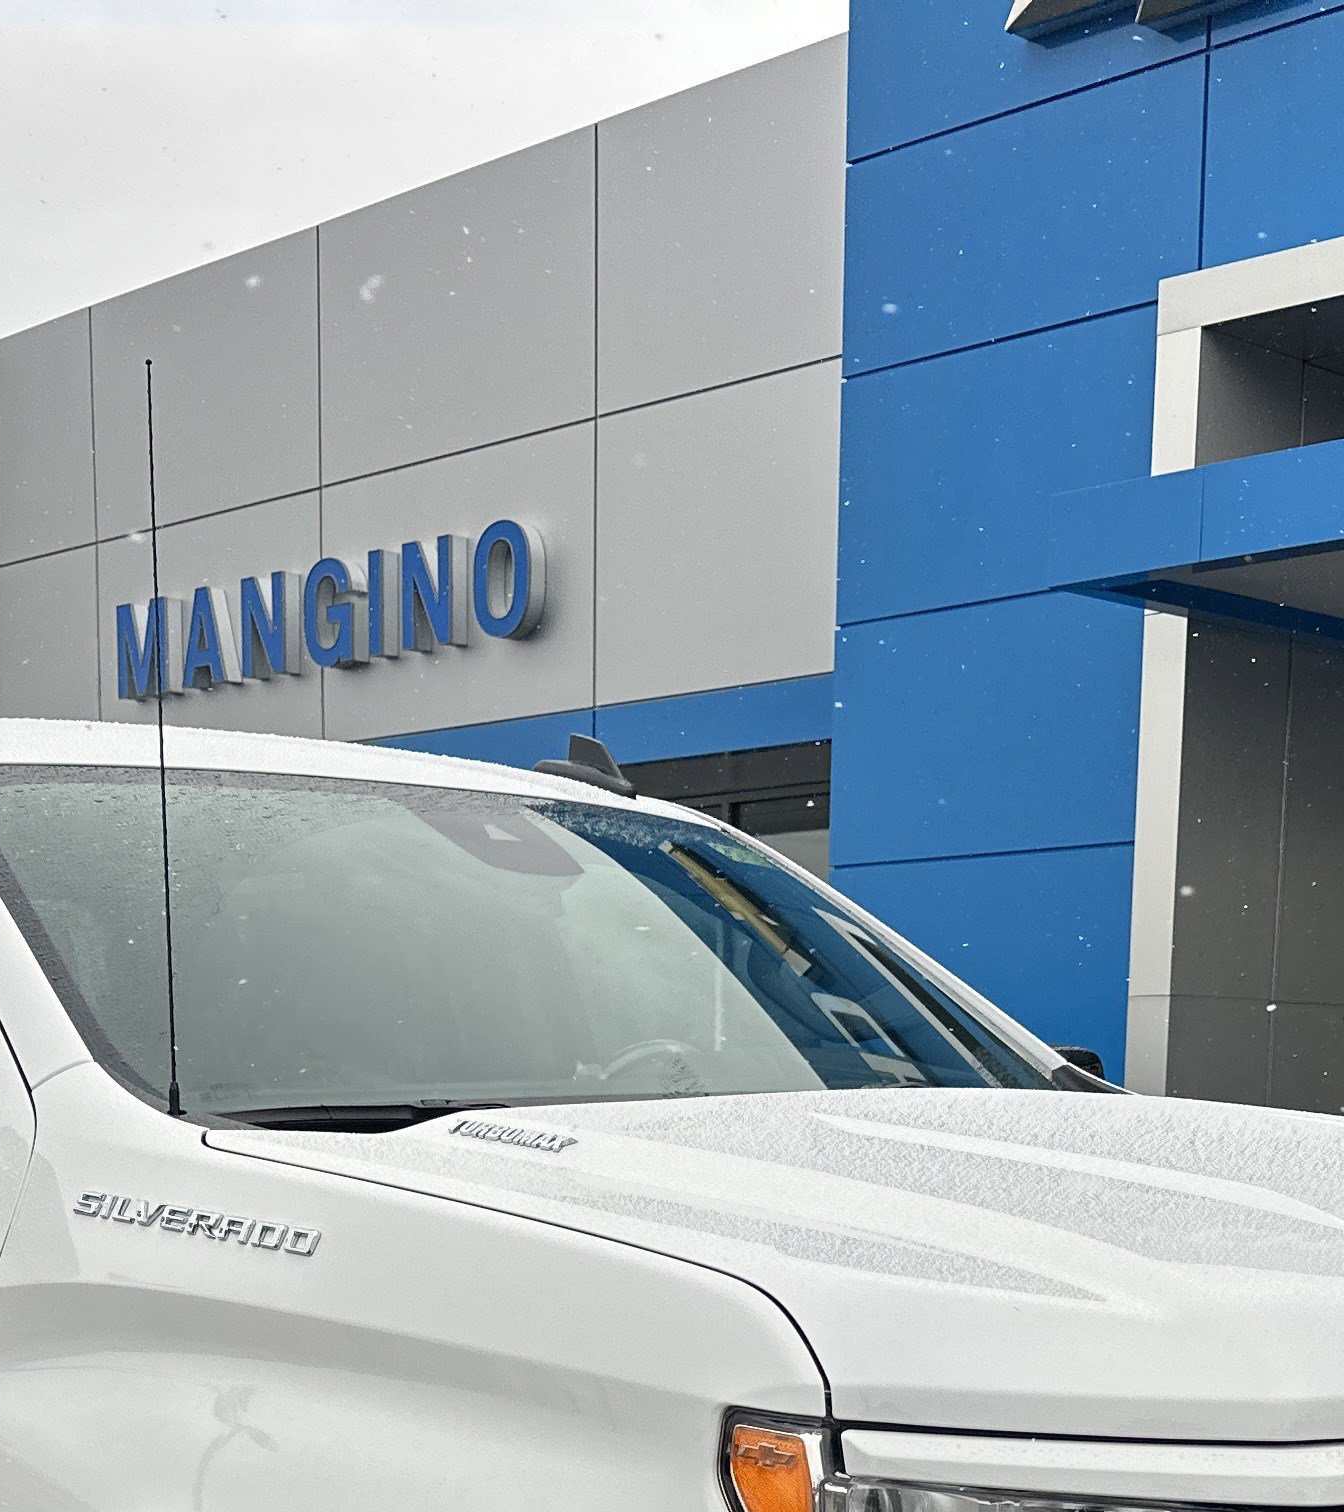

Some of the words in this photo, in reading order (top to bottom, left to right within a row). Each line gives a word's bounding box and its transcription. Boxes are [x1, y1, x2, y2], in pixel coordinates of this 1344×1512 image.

[115, 518, 540, 700] MANGINO
[448, 1118, 576, 1152] TURBOMAX
[73, 1190, 321, 1256] SILVERADO
